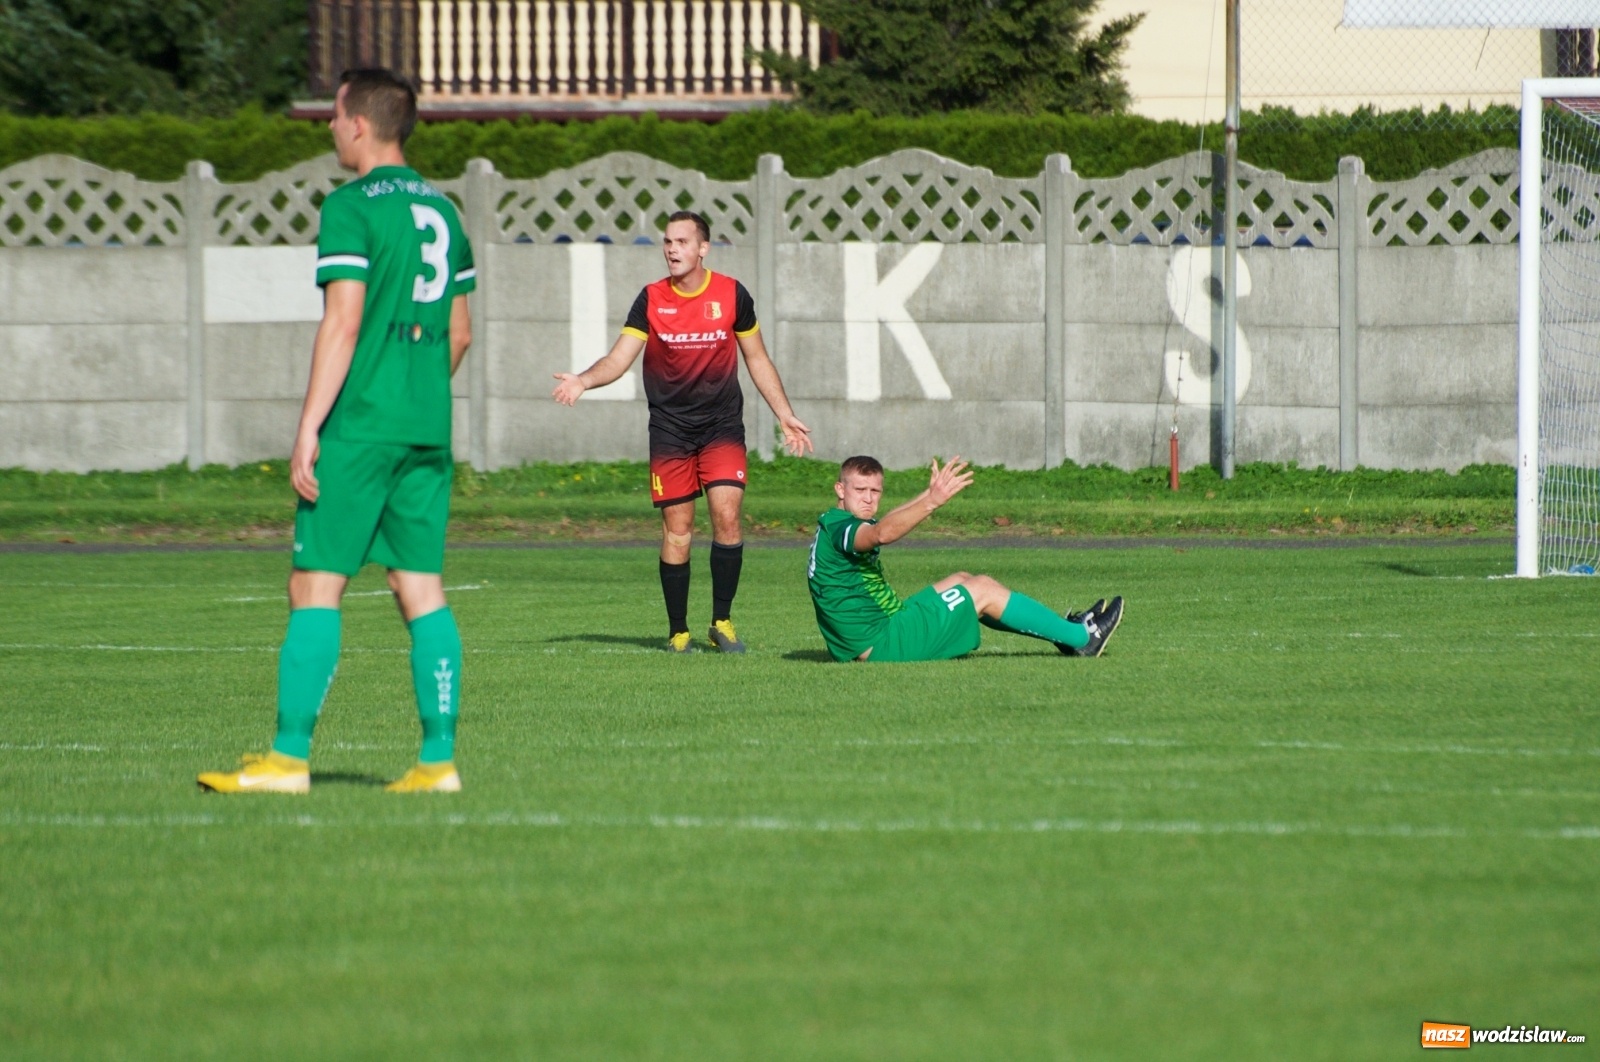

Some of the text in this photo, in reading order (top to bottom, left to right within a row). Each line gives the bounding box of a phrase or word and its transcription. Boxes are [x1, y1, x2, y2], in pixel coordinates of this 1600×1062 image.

[410, 202, 450, 304] 3
[657, 329, 728, 344] mazur
[652, 472, 664, 497] 4
[940, 587, 966, 612] 10
